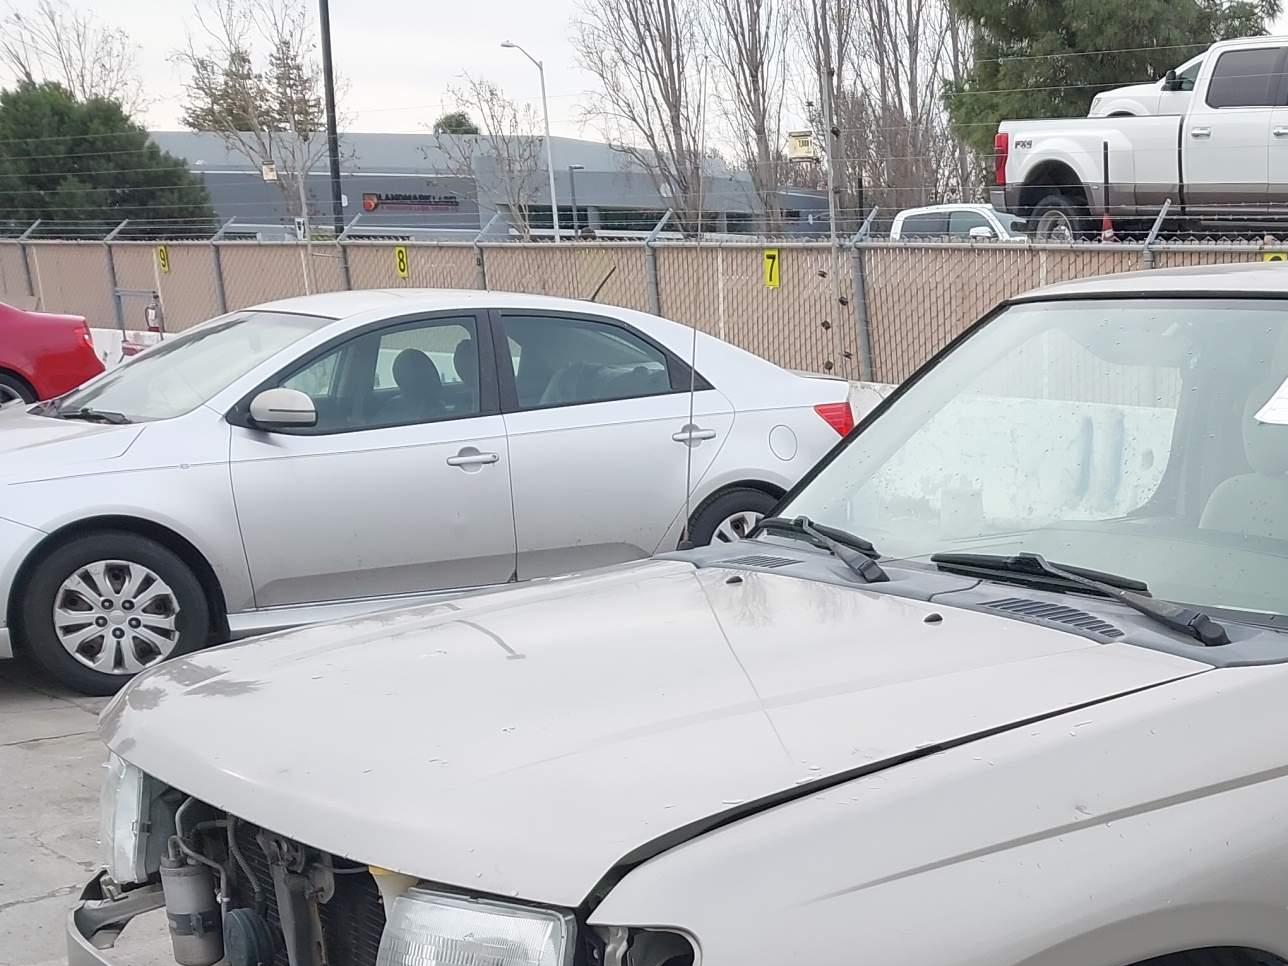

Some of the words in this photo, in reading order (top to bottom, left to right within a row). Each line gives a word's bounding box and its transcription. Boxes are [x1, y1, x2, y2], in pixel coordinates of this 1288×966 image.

[160, 249, 166, 267] 9
[398, 250, 405, 272] 8
[766, 254, 776, 282] 7
